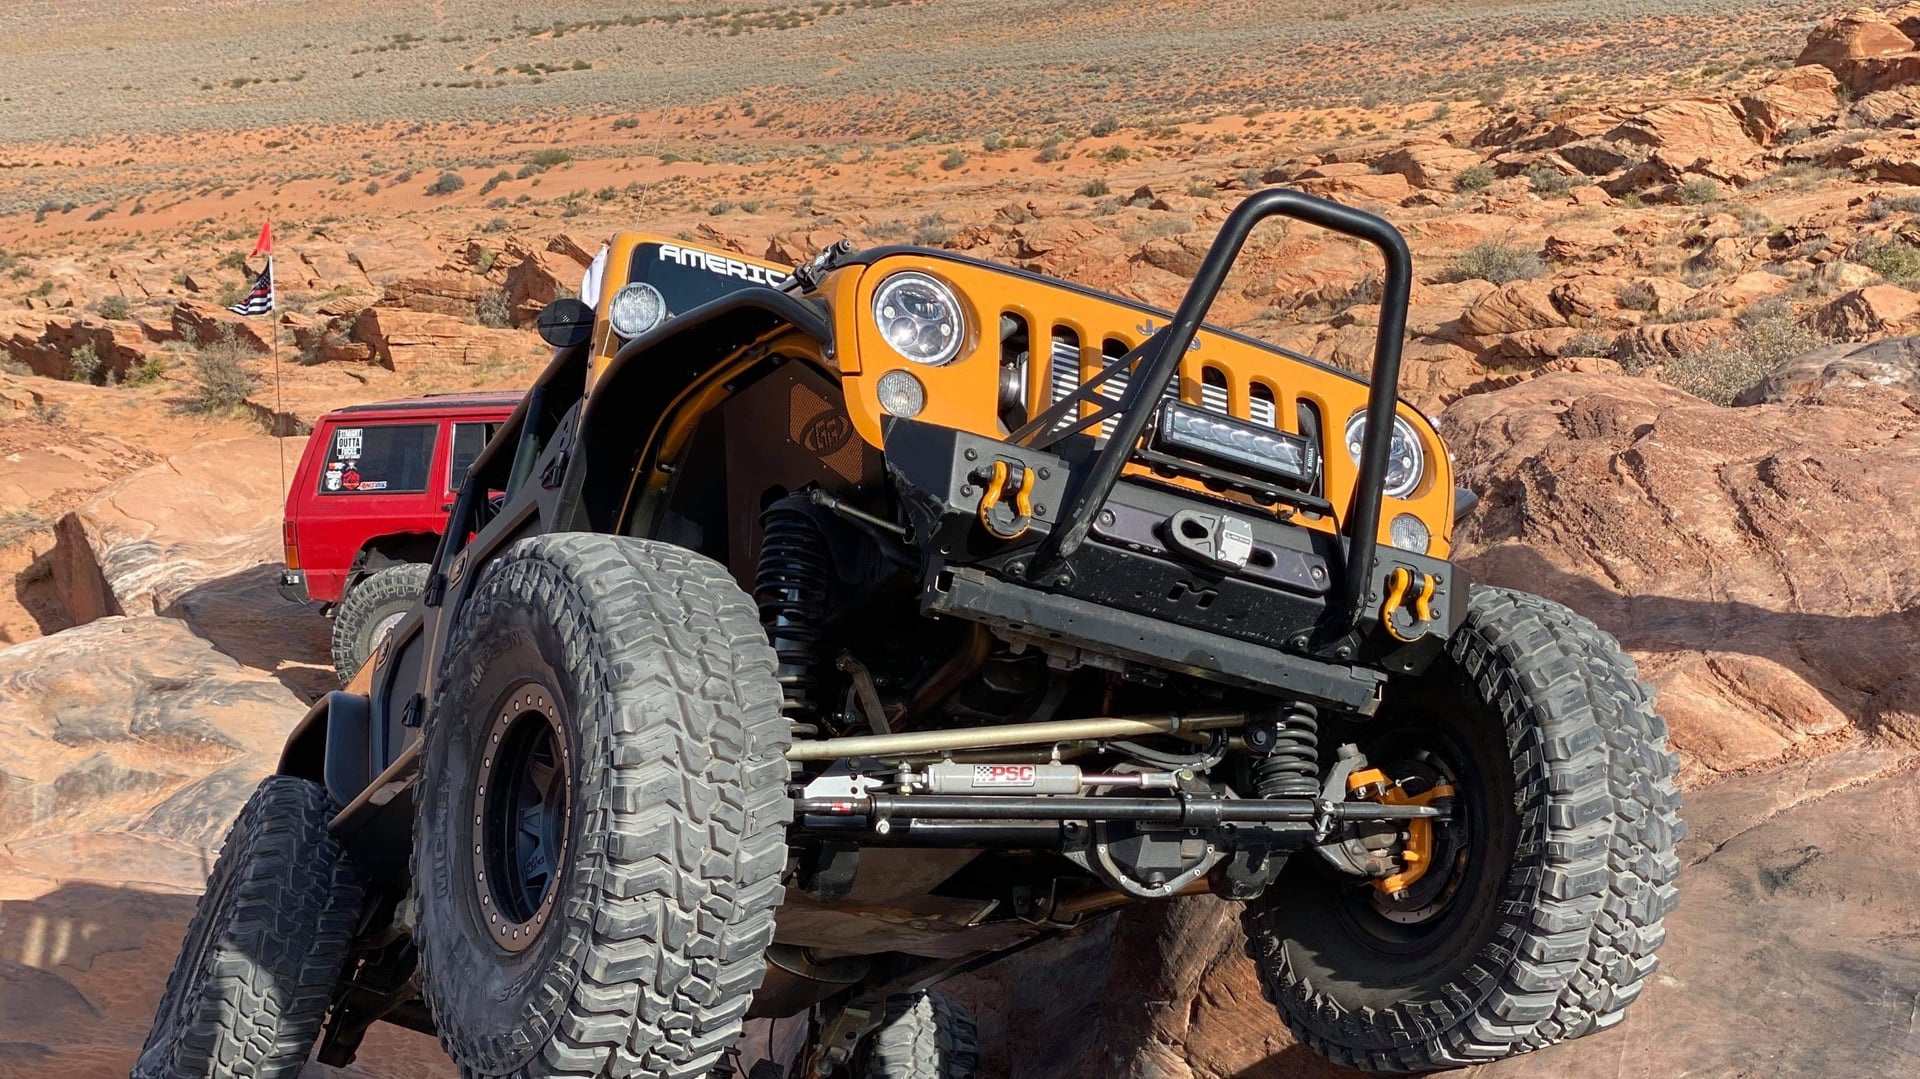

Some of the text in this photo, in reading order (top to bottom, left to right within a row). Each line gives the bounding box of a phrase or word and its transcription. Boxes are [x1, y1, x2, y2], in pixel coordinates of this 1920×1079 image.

[659, 245, 796, 287] AMERIC
[339, 438, 360, 447] OUTTA
[992, 766, 1033, 781] PSC
